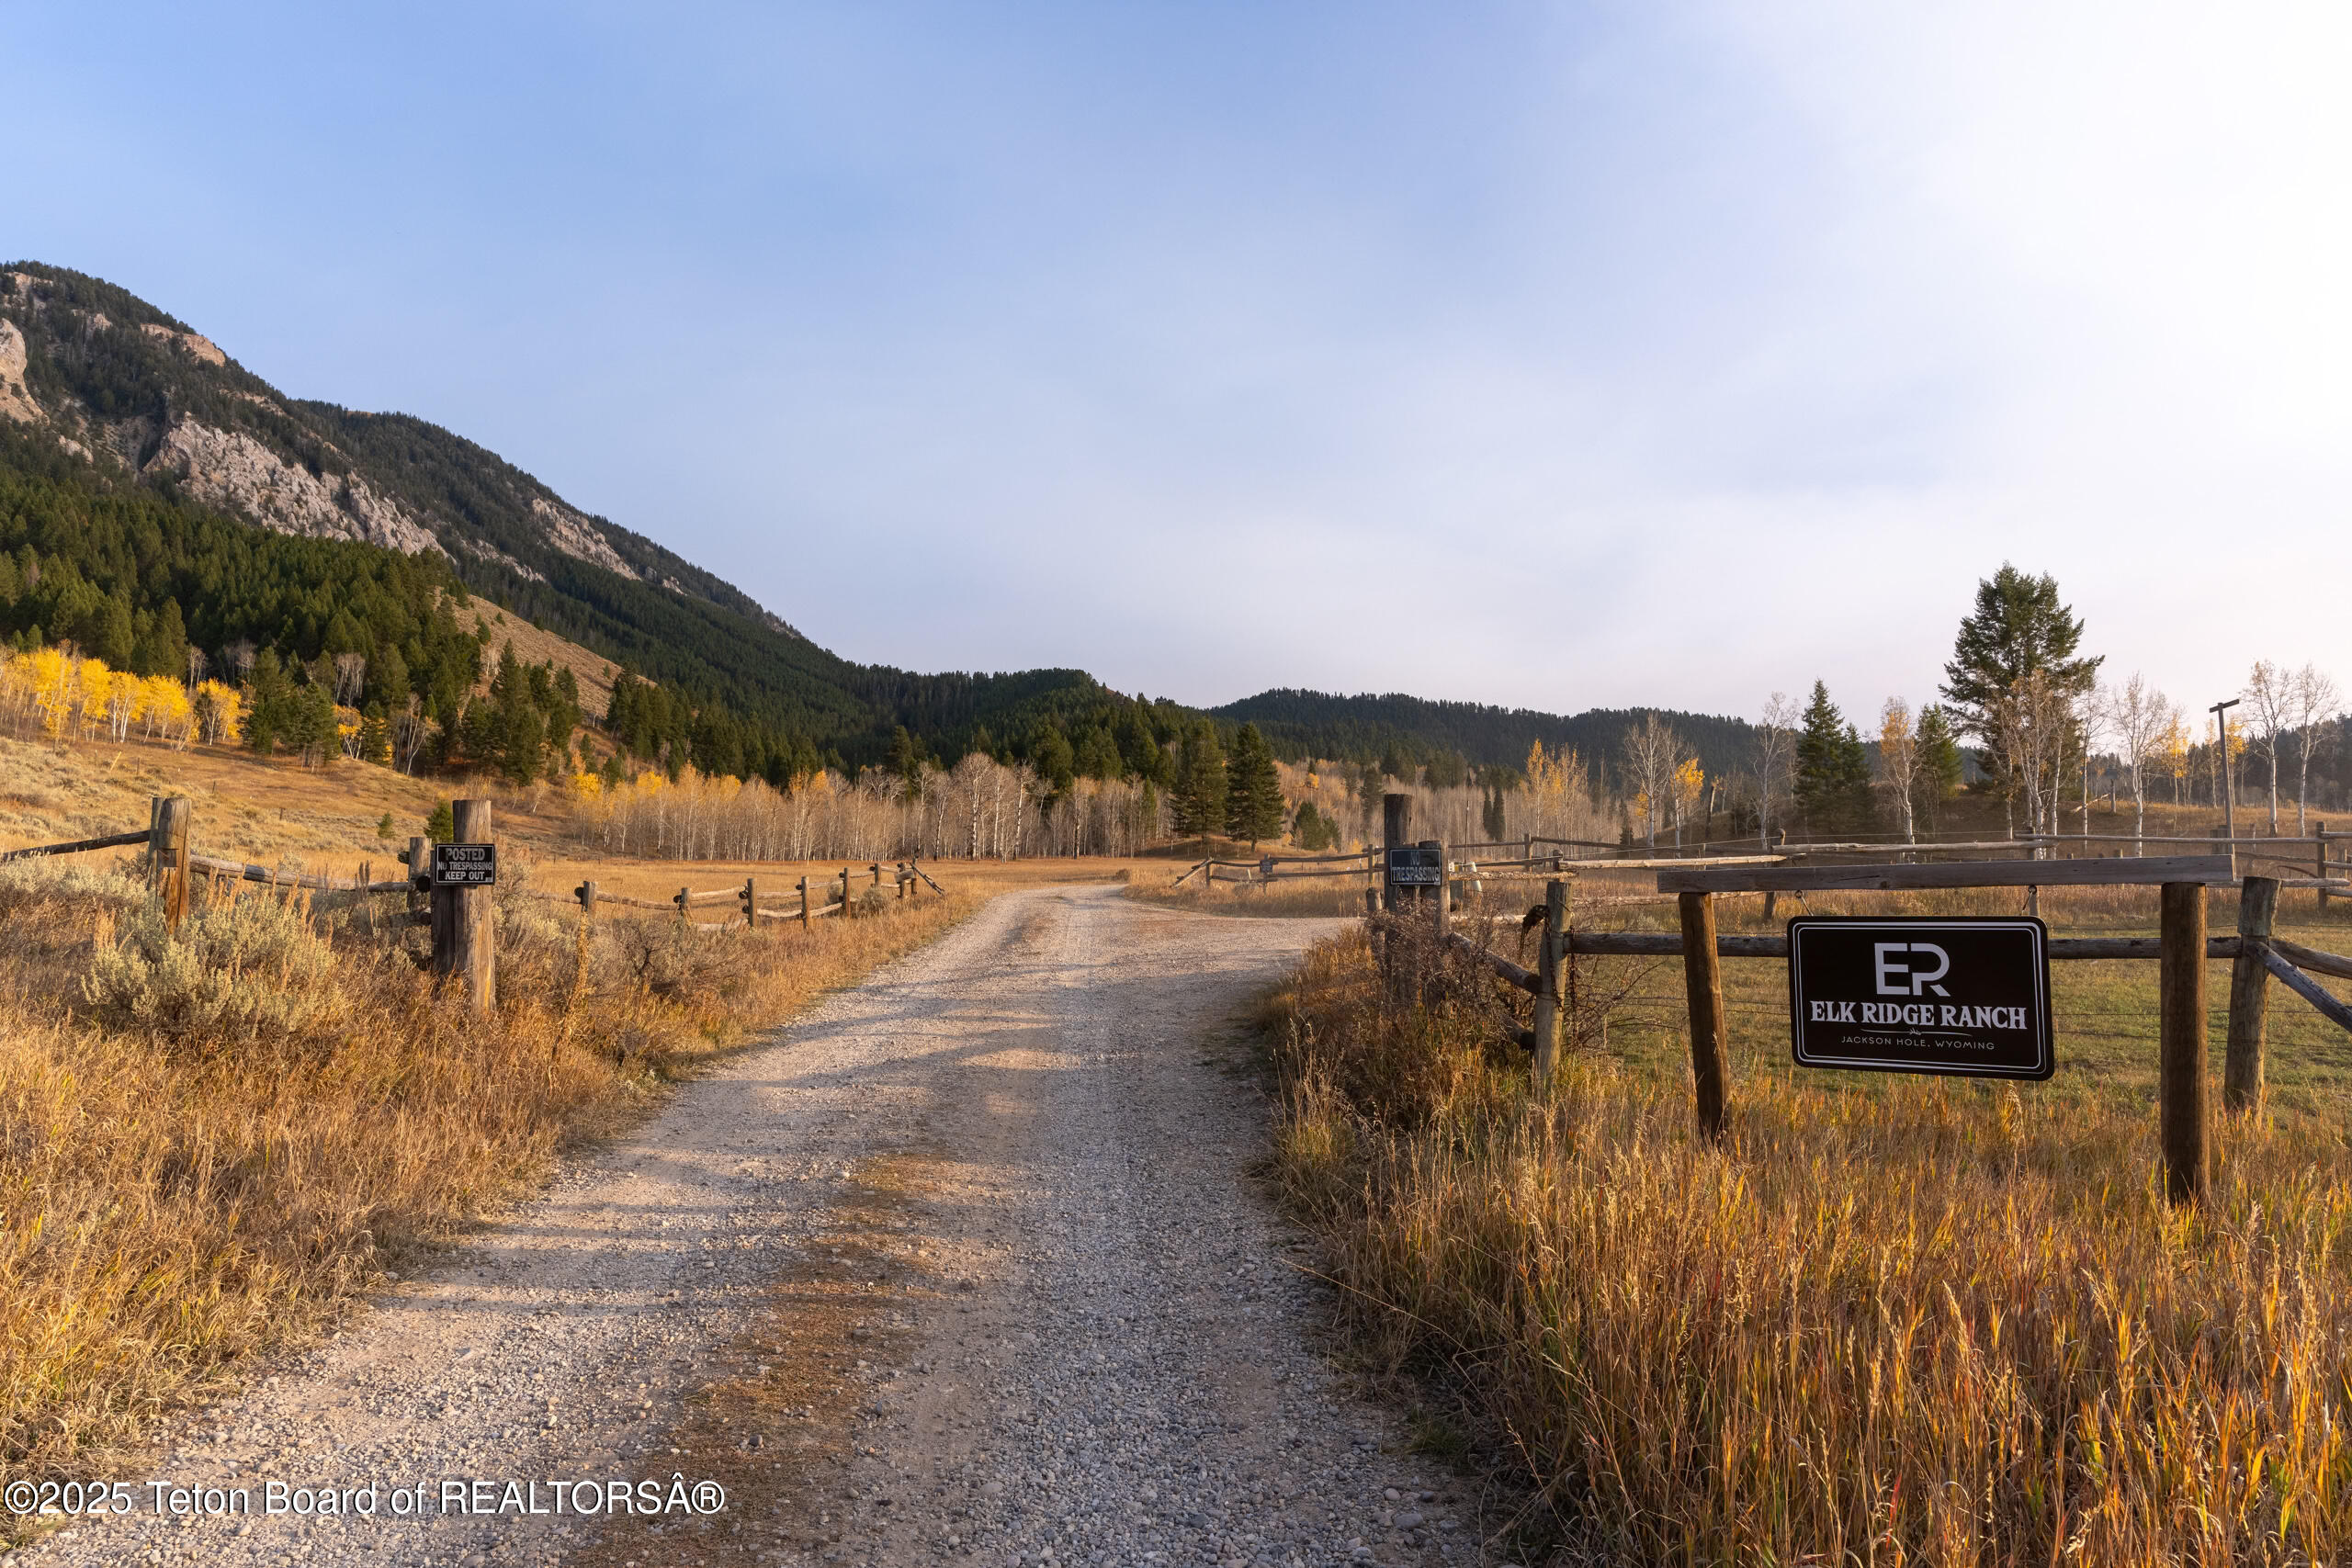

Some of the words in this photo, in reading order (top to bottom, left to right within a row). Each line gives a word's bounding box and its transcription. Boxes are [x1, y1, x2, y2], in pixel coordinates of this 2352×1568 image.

[445, 848, 485, 861] POSTED
[1410, 852, 1420, 865] NO
[437, 862, 447, 871] NO
[449, 862, 492, 871] TRESPASSING
[445, 871, 466, 880] KEEP
[469, 871, 485, 880] OUT
[1392, 866, 1440, 882] TRESPASSING
[1874, 942, 1951, 997] ER
[1810, 1000, 1856, 1023] ELK
[1860, 1002, 1935, 1026] RIDGE
[1939, 1005, 2028, 1030] RANCH
[1841, 1036, 1892, 1045] JACKSON
[1935, 1041, 1995, 1050] WYOMING
